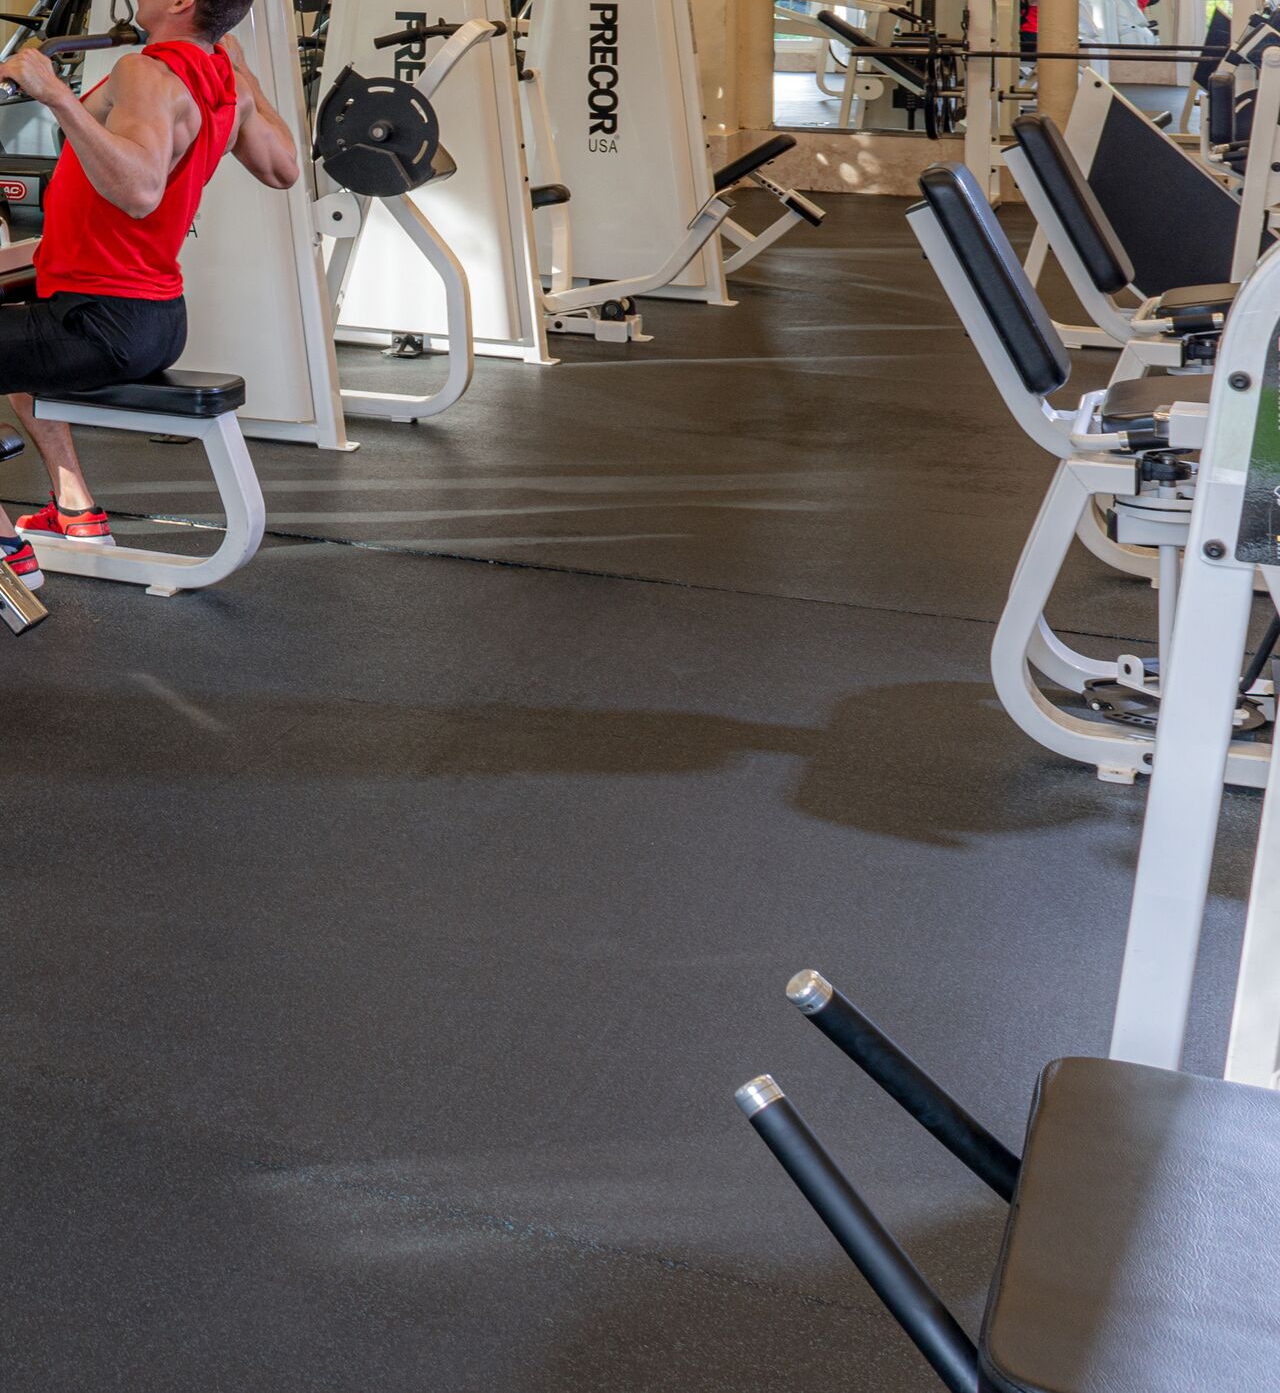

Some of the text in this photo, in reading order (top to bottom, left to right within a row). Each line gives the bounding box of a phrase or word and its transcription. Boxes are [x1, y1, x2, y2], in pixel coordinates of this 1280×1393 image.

[394, 11, 427, 85] PRE
[588, 3, 618, 135] PRECOR
[588, 138, 618, 154] USA
